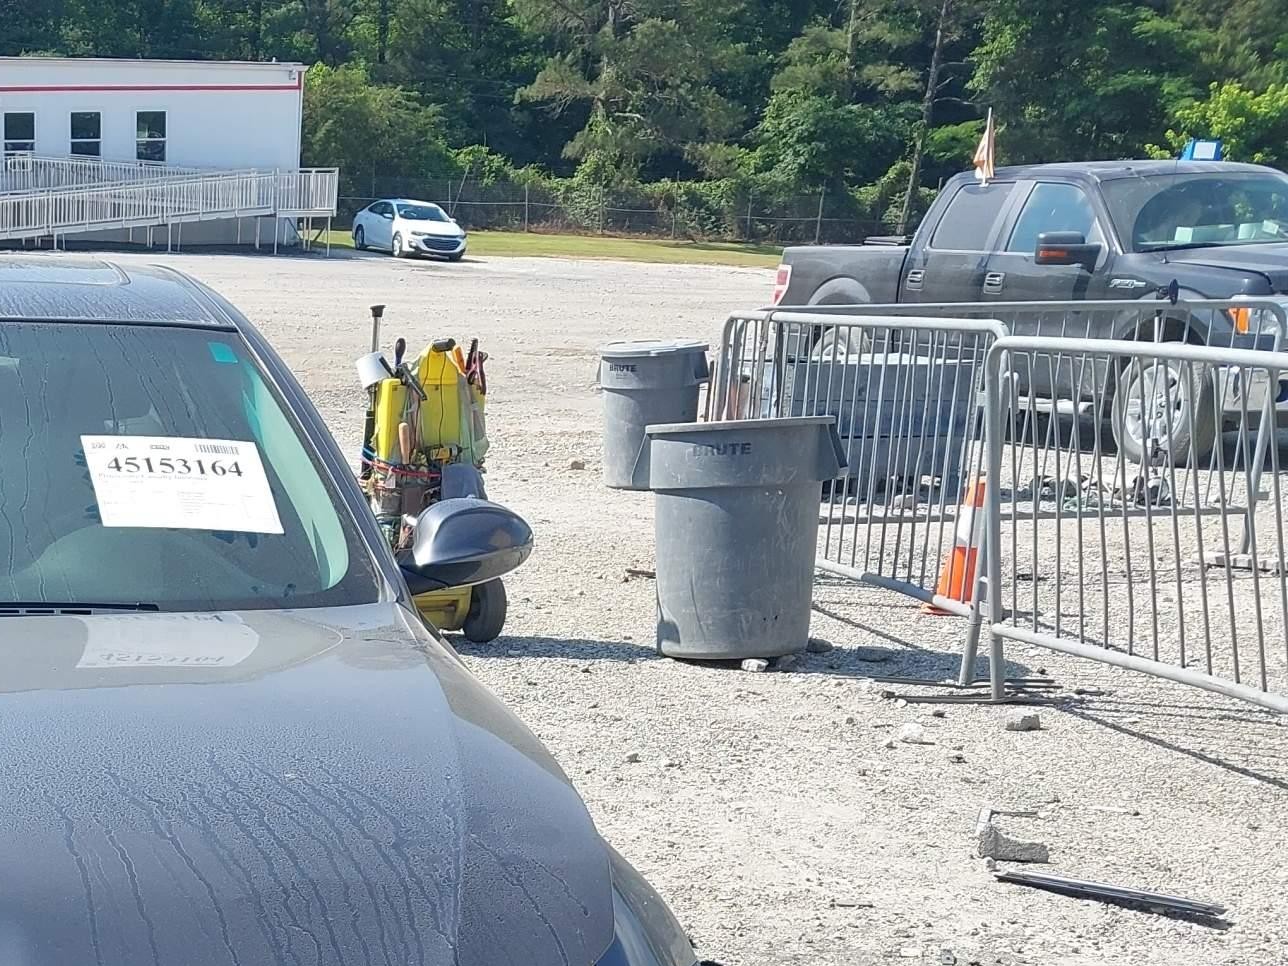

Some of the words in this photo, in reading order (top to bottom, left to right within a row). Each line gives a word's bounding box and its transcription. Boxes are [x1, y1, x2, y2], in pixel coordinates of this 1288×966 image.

[609, 363, 637, 373] BRUTE
[692, 442, 752, 457] BRUTE
[107, 456, 243, 478] 45153164
